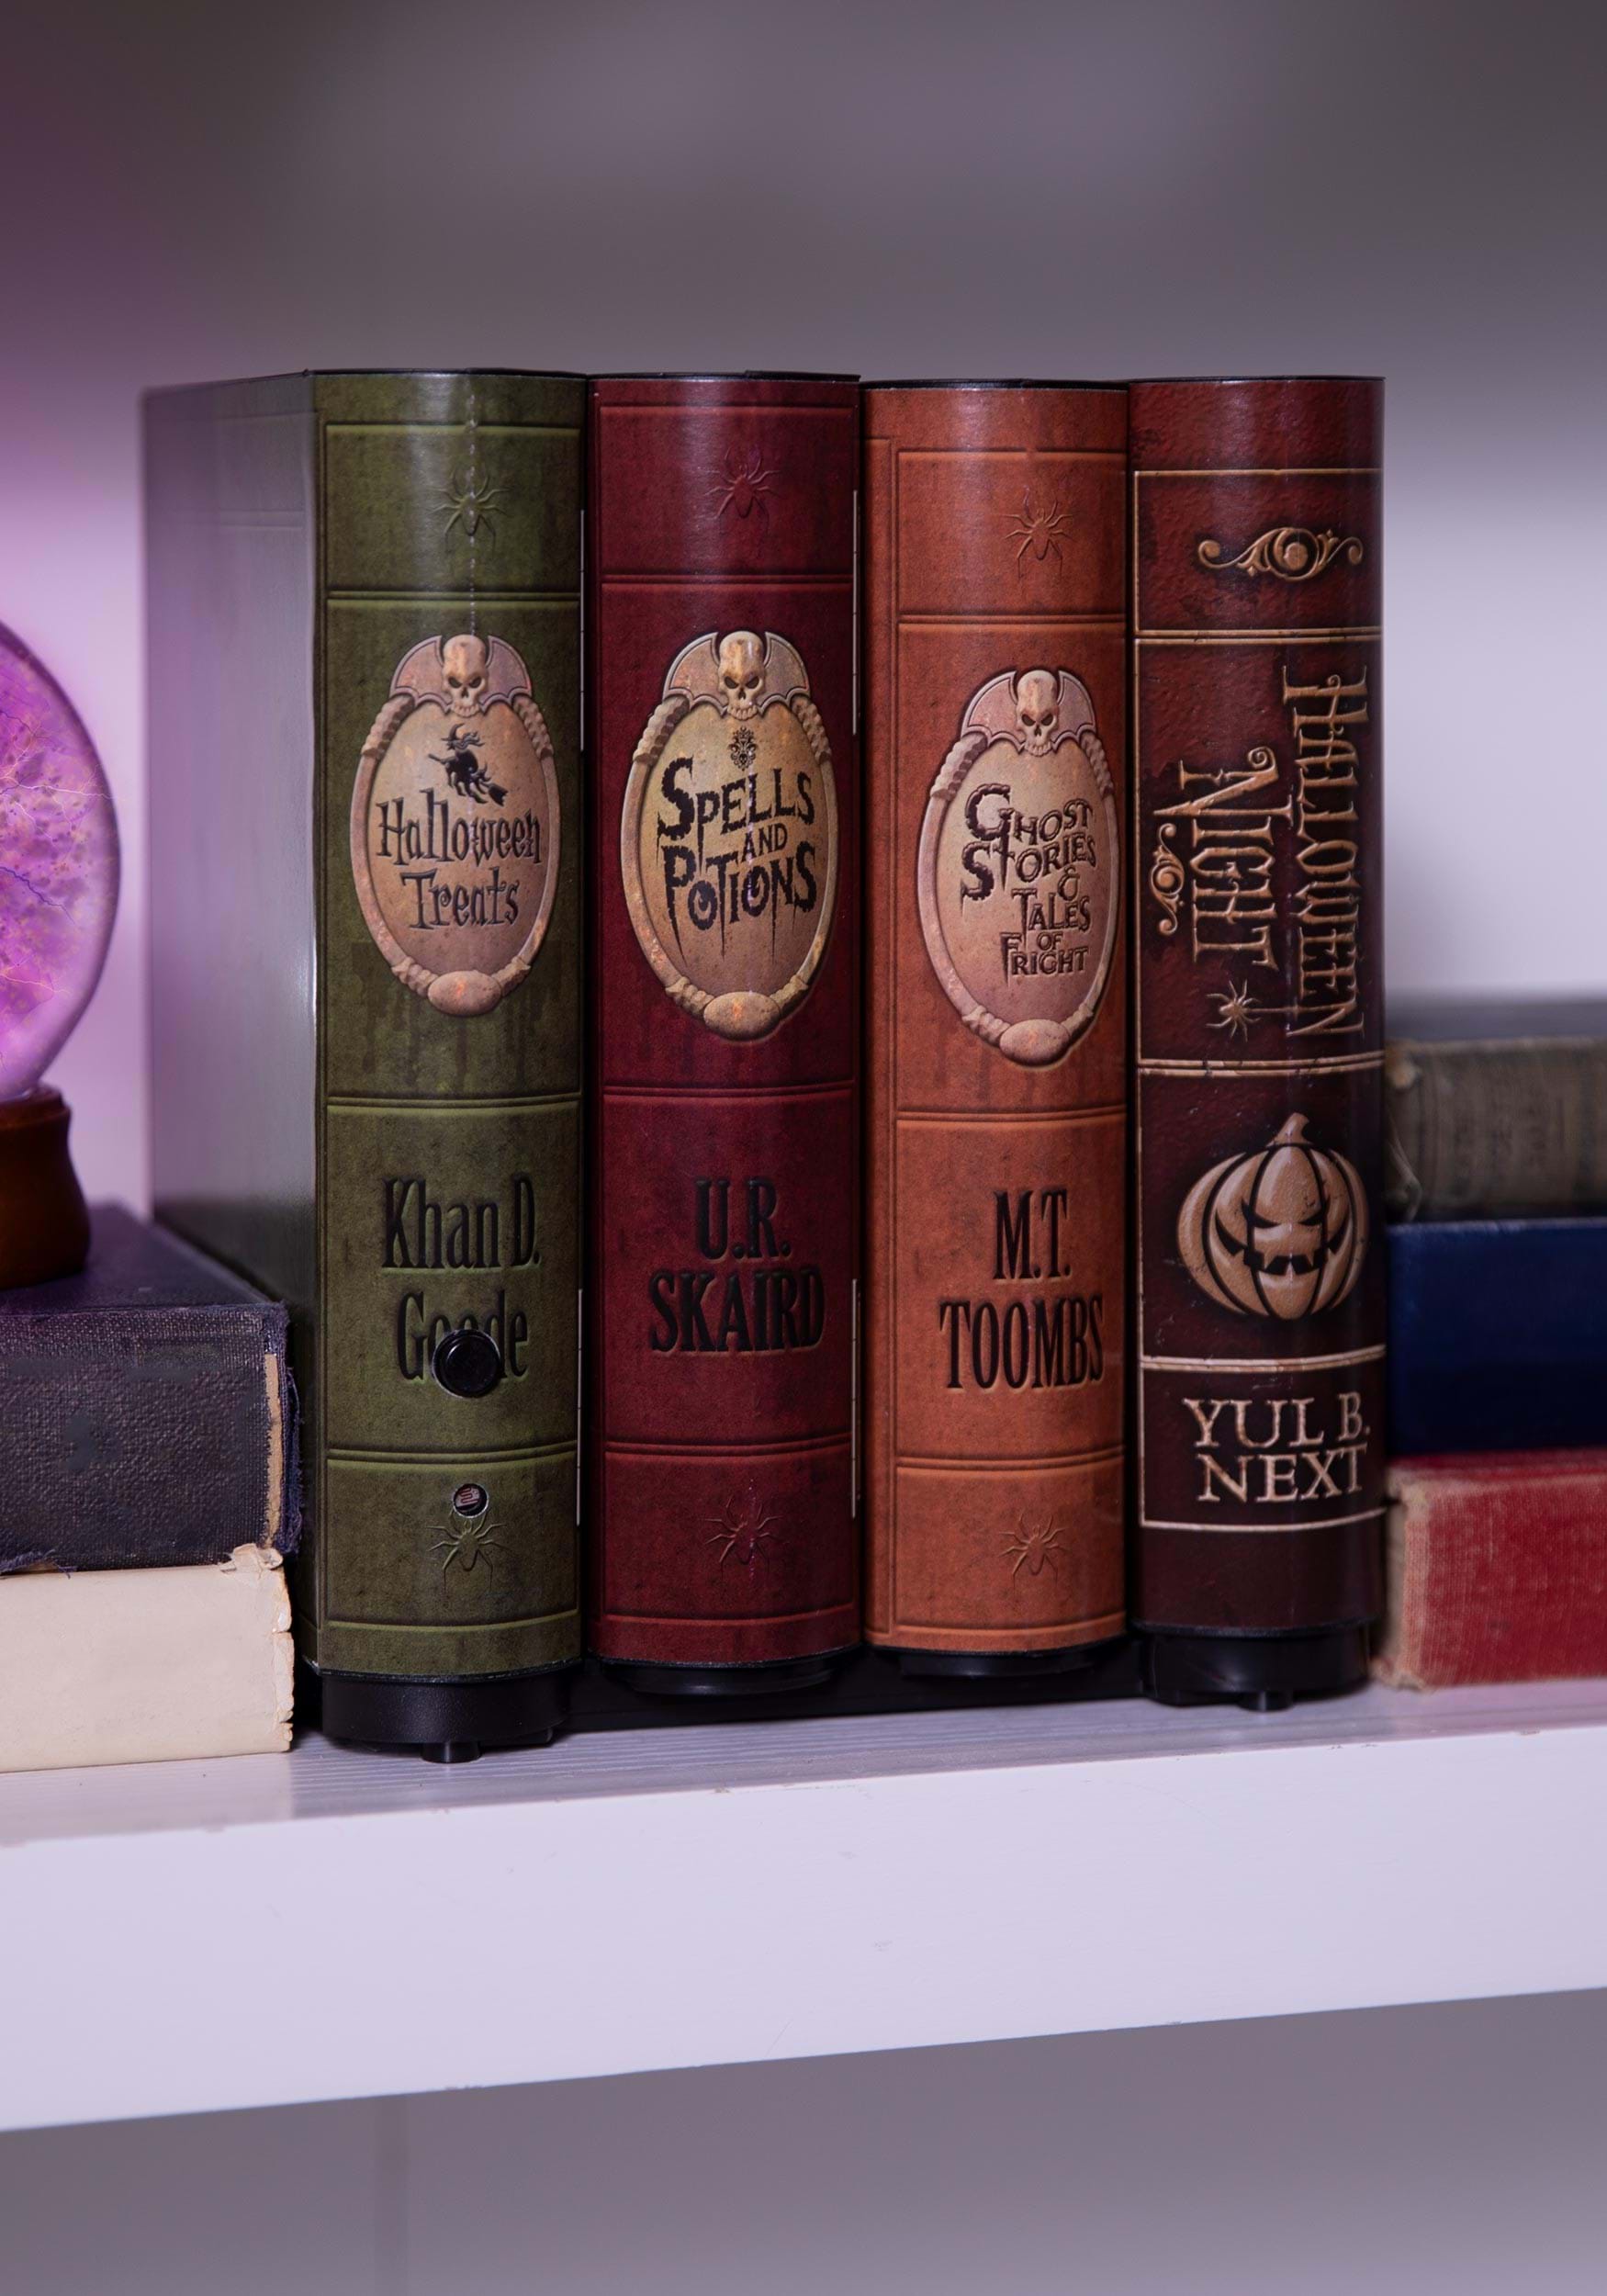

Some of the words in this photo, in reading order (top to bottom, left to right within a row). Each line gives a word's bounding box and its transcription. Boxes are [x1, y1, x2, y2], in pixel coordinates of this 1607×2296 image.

[376, 787, 542, 866] Halloween
[657, 758, 815, 874] SPELLS
[742, 822, 788, 864] AND
[965, 783, 1095, 845] GHOST
[1283, 665, 1368, 1038] HALLOWEEN
[961, 832, 1096, 905] STORIES
[1057, 867, 1080, 902] &
[1153, 746, 1294, 971] NIGHT
[400, 866, 519, 929] Treats
[661, 841, 817, 964] POTIONS
[1011, 888, 1090, 940] TALES
[999, 932, 1089, 983] FRIGHT
[1037, 930, 1063, 951] OF
[381, 1178, 500, 1269] Khan
[511, 1175, 541, 1267] D.
[694, 1176, 792, 1260] U.R.
[994, 1189, 1071, 1279] M.T.
[650, 1266, 825, 1354] SKAIRD
[939, 1296, 1103, 1390] TOOMBS
[1183, 1397, 1324, 1448] YUL
[1337, 1391, 1371, 1442] B.
[1197, 1443, 1368, 1502] NEXT
